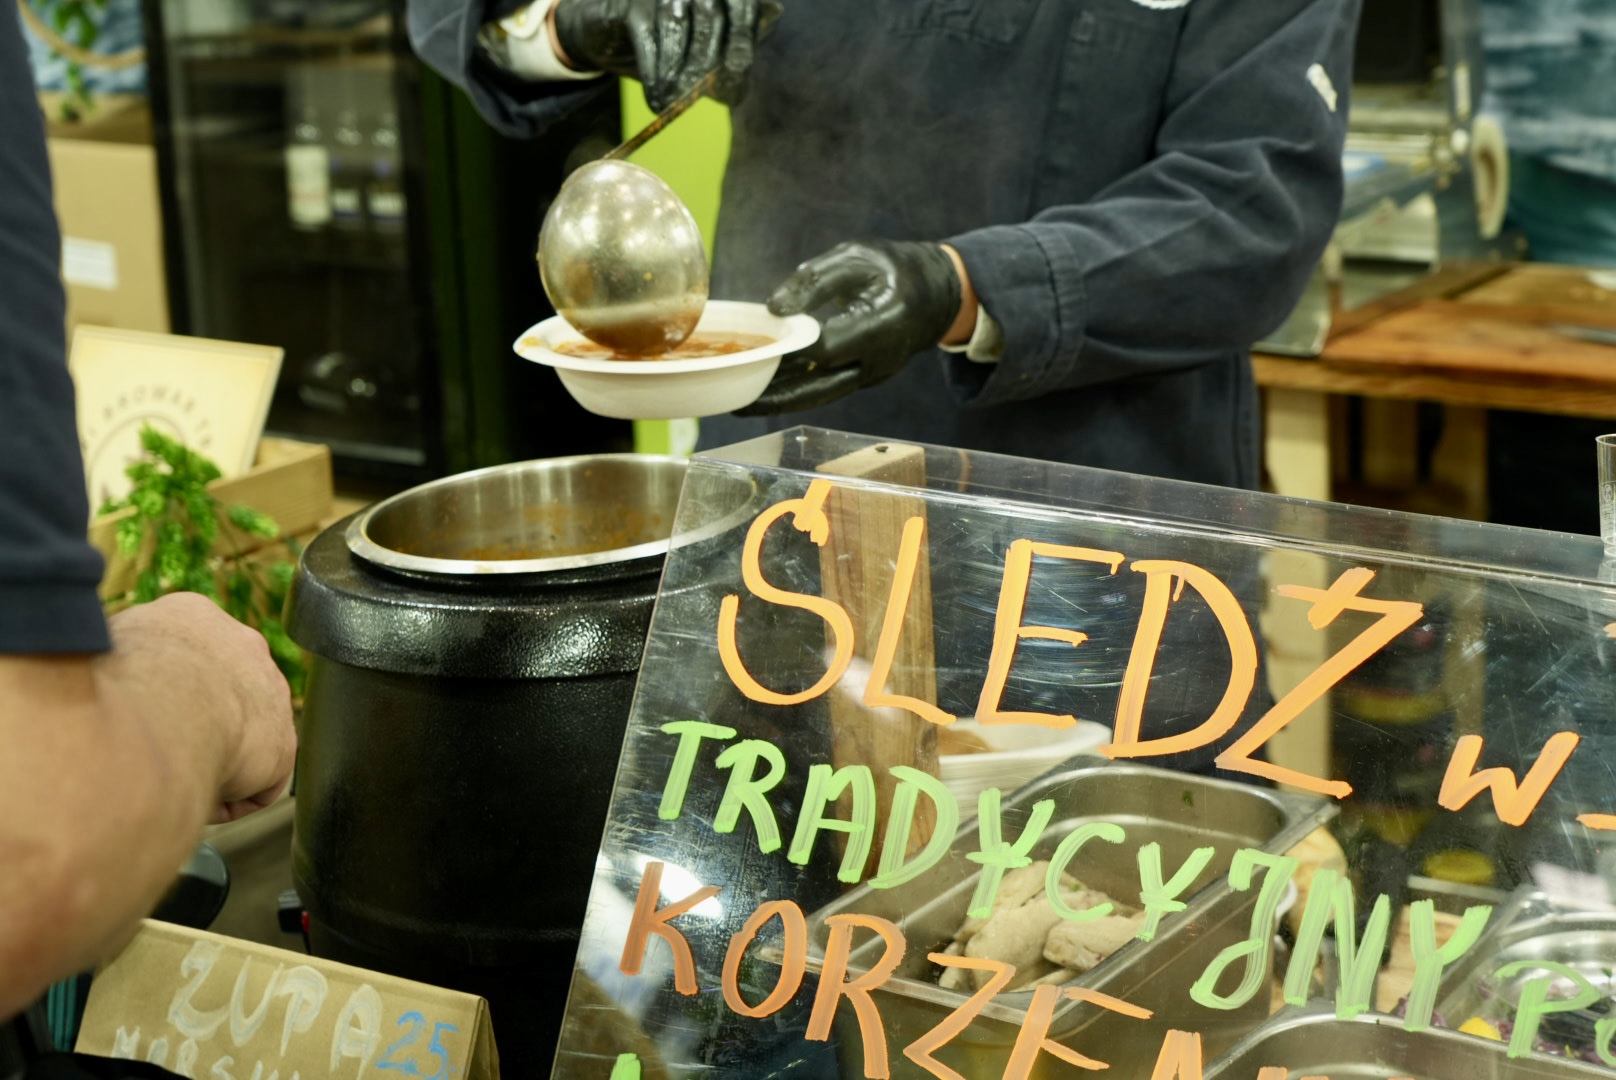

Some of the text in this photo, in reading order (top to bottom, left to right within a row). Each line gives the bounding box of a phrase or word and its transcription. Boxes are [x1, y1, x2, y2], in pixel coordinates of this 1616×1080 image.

[167, 938, 462, 1080] ZUPA 25
[1493, 958, 1616, 1067] P
